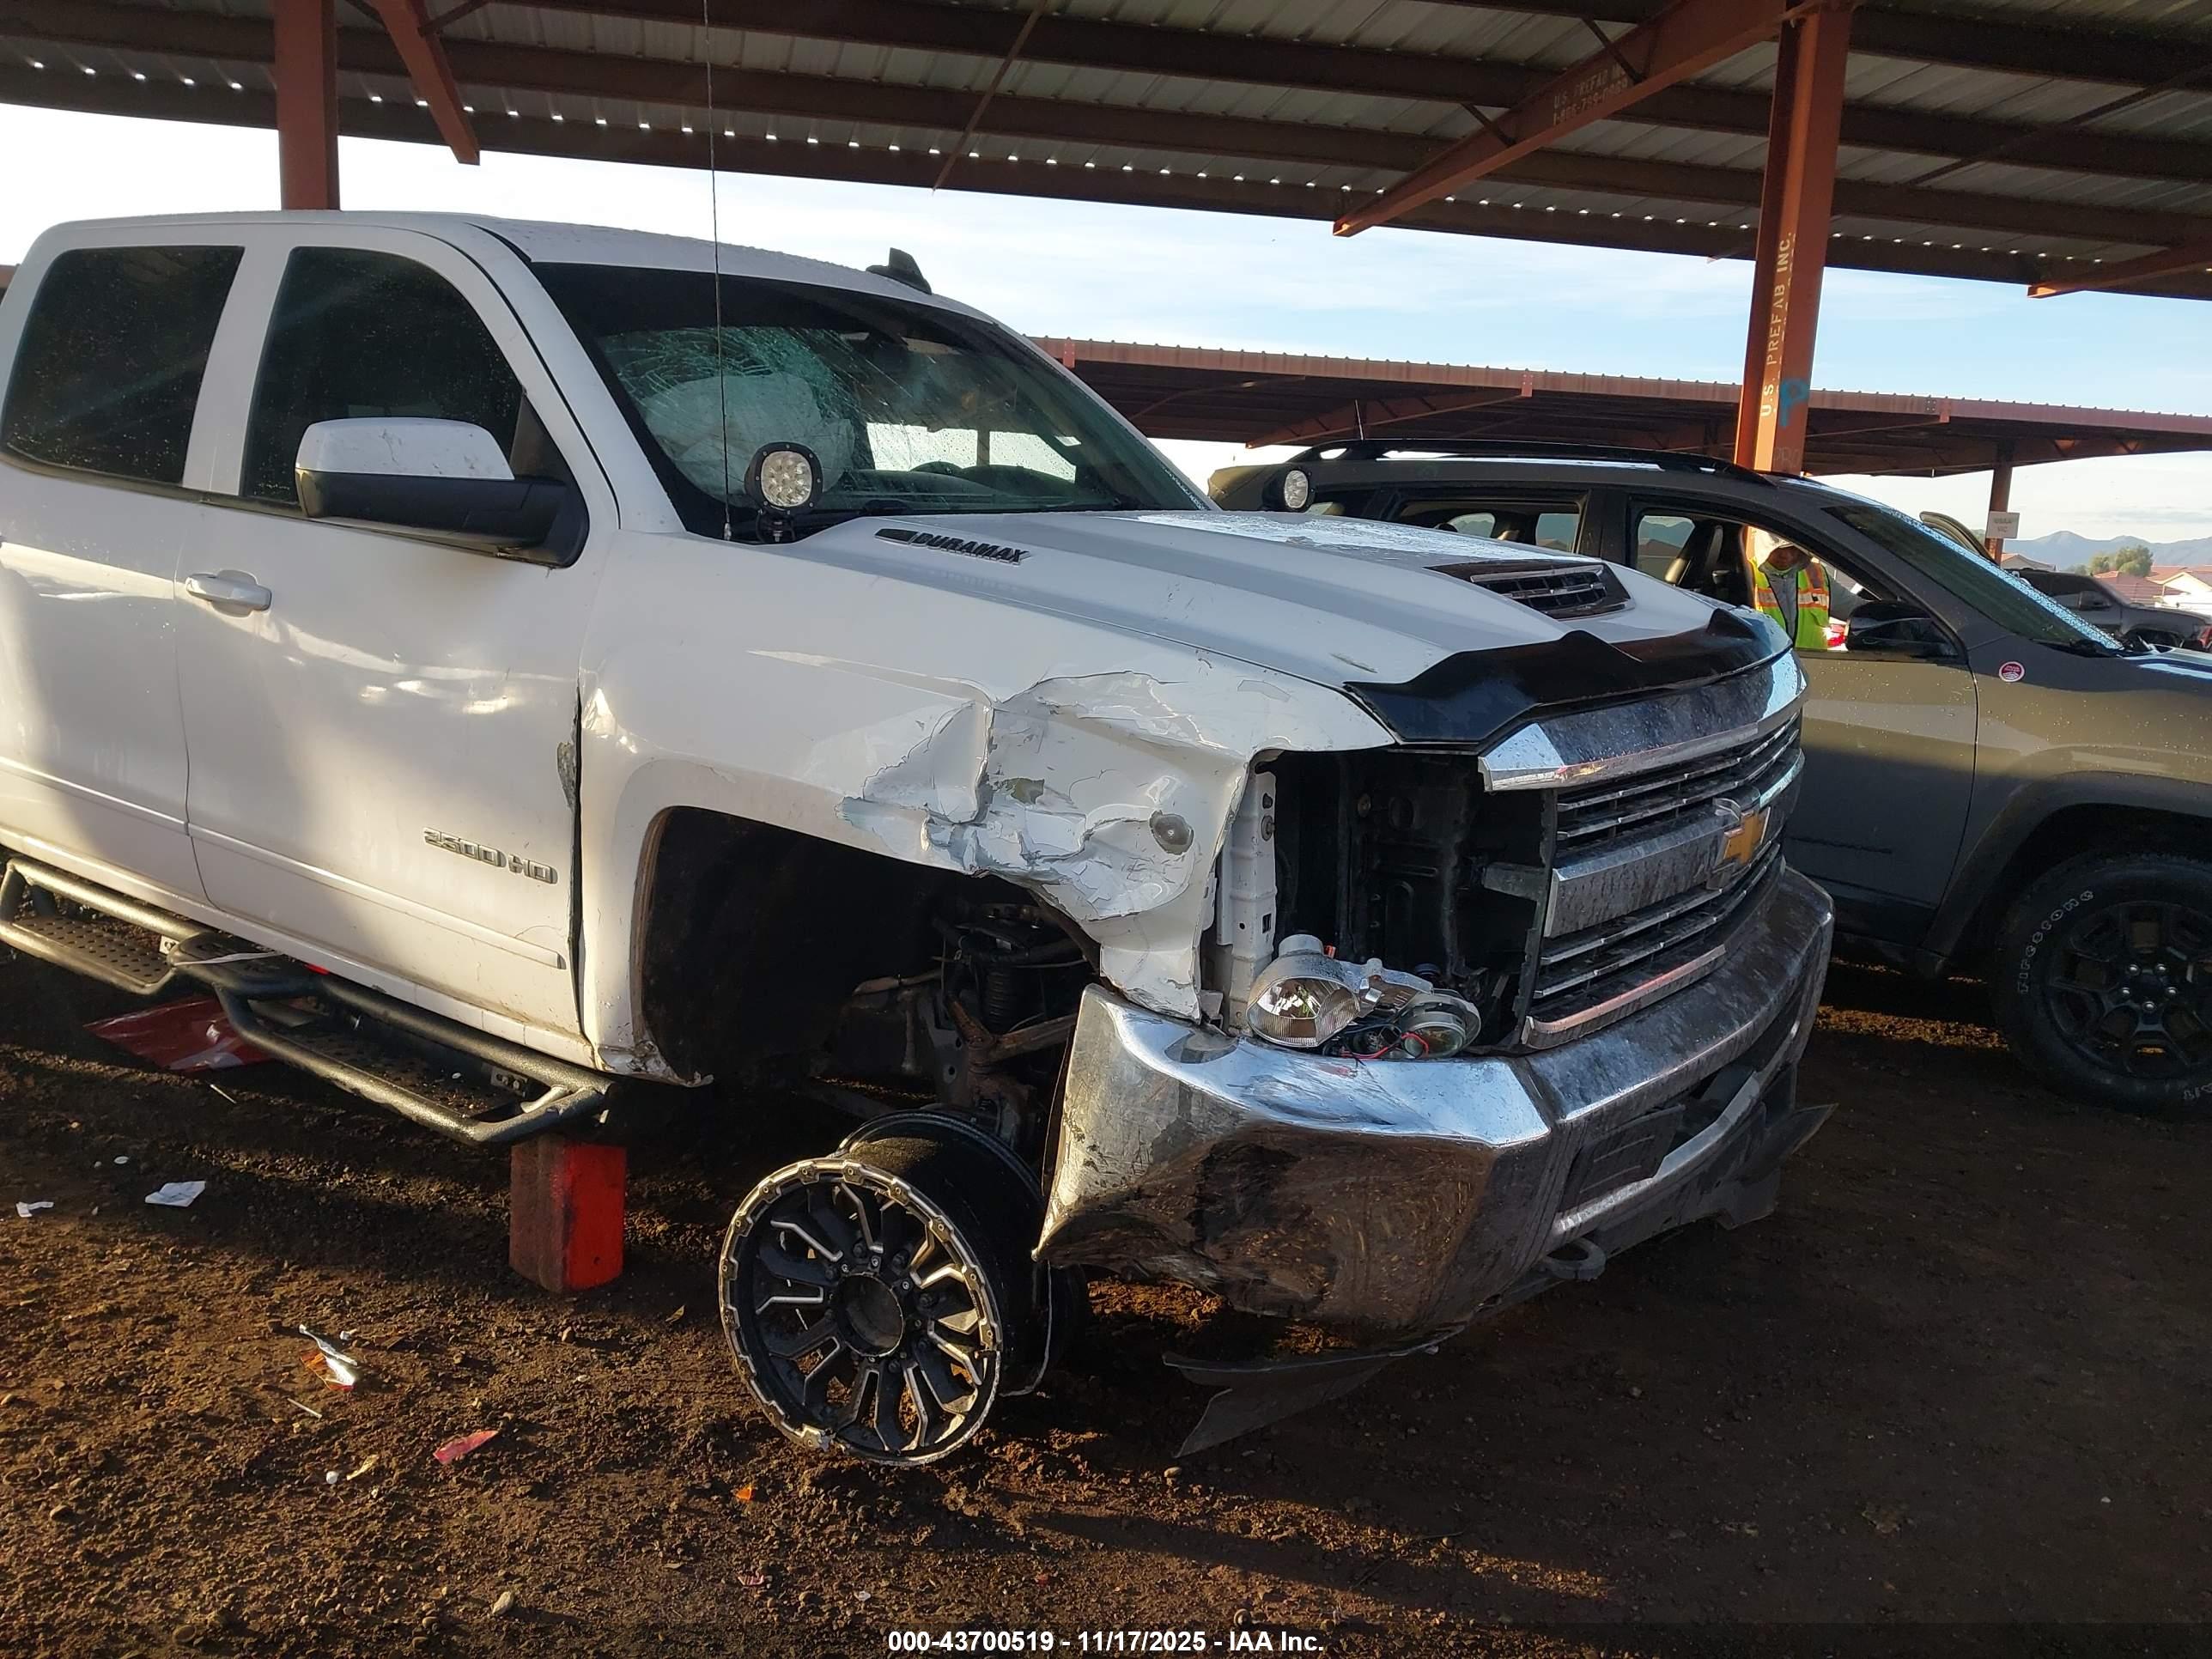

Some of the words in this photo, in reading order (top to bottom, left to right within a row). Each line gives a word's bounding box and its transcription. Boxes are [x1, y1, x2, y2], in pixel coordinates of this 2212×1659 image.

[1777, 232, 1792, 272] INC.
[1765, 284, 1785, 365] PREFAB
[1760, 378, 1775, 417] U.S.
[911, 531, 1031, 565] DURAMAX
[423, 827, 507, 867] 2500
[507, 853, 558, 884] HD
